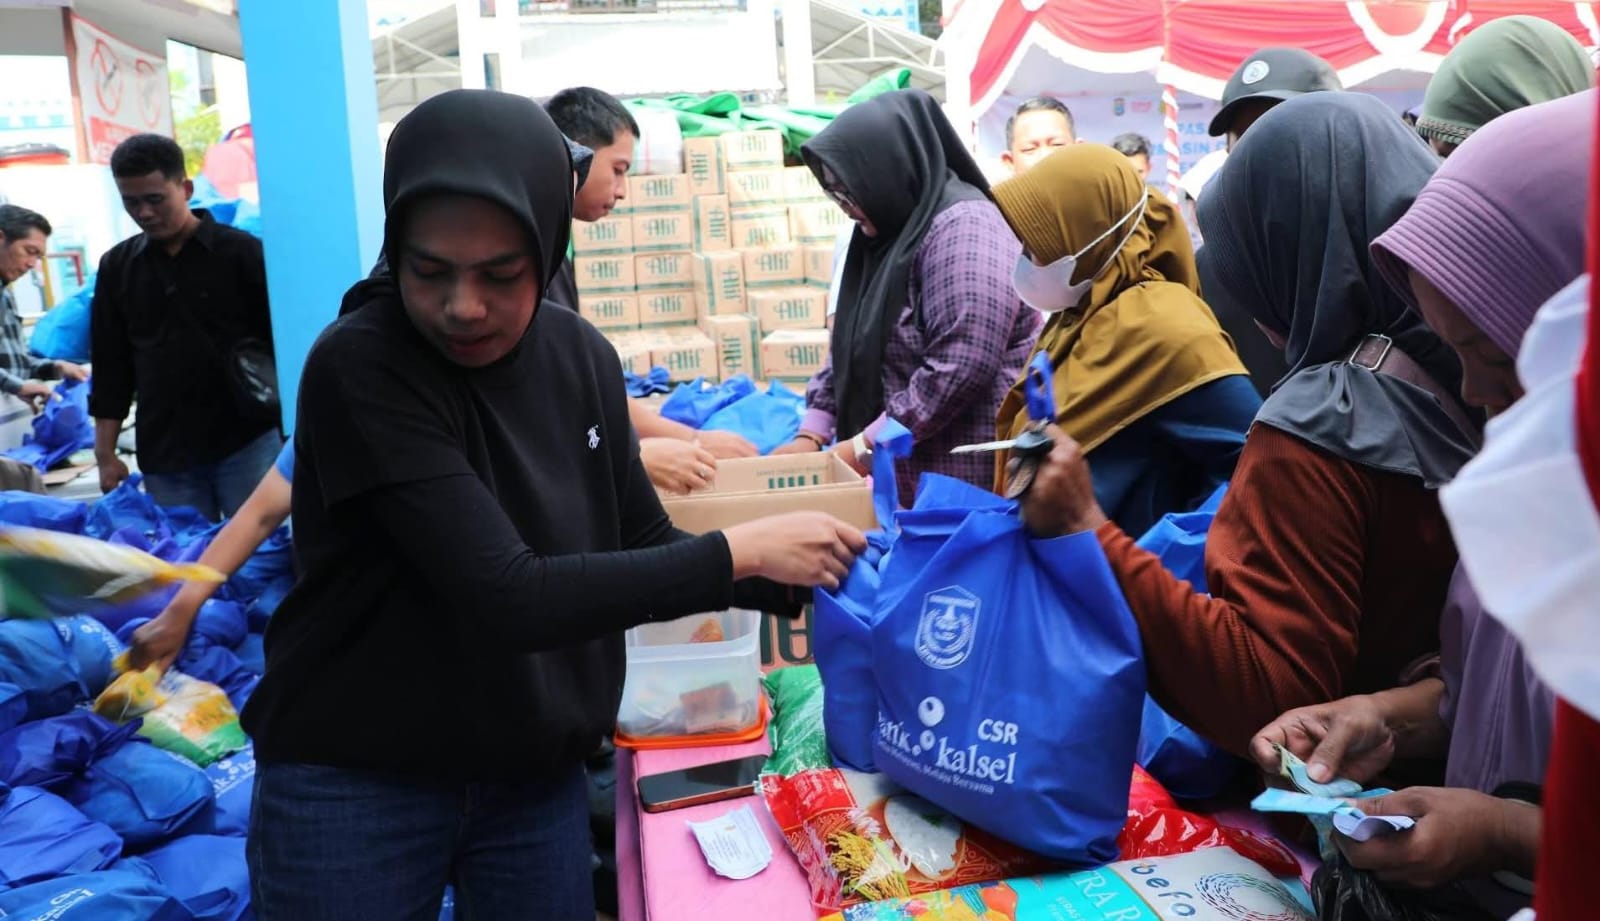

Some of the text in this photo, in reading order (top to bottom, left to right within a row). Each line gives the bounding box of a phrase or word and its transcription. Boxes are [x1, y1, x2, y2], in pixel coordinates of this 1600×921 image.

[640, 178, 677, 197] Alif
[583, 220, 622, 241] Alif
[643, 216, 681, 236] Alif
[585, 259, 624, 279] Alif
[645, 254, 683, 275] Alif
[753, 250, 795, 273] Alif
[590, 299, 628, 318] Alif
[648, 294, 685, 314] Alif
[772, 297, 814, 321] Alif
[662, 348, 704, 371] Alif
[784, 344, 824, 366] Alif
[977, 718, 1019, 746] CSR
[935, 736, 1018, 785] kalsel
